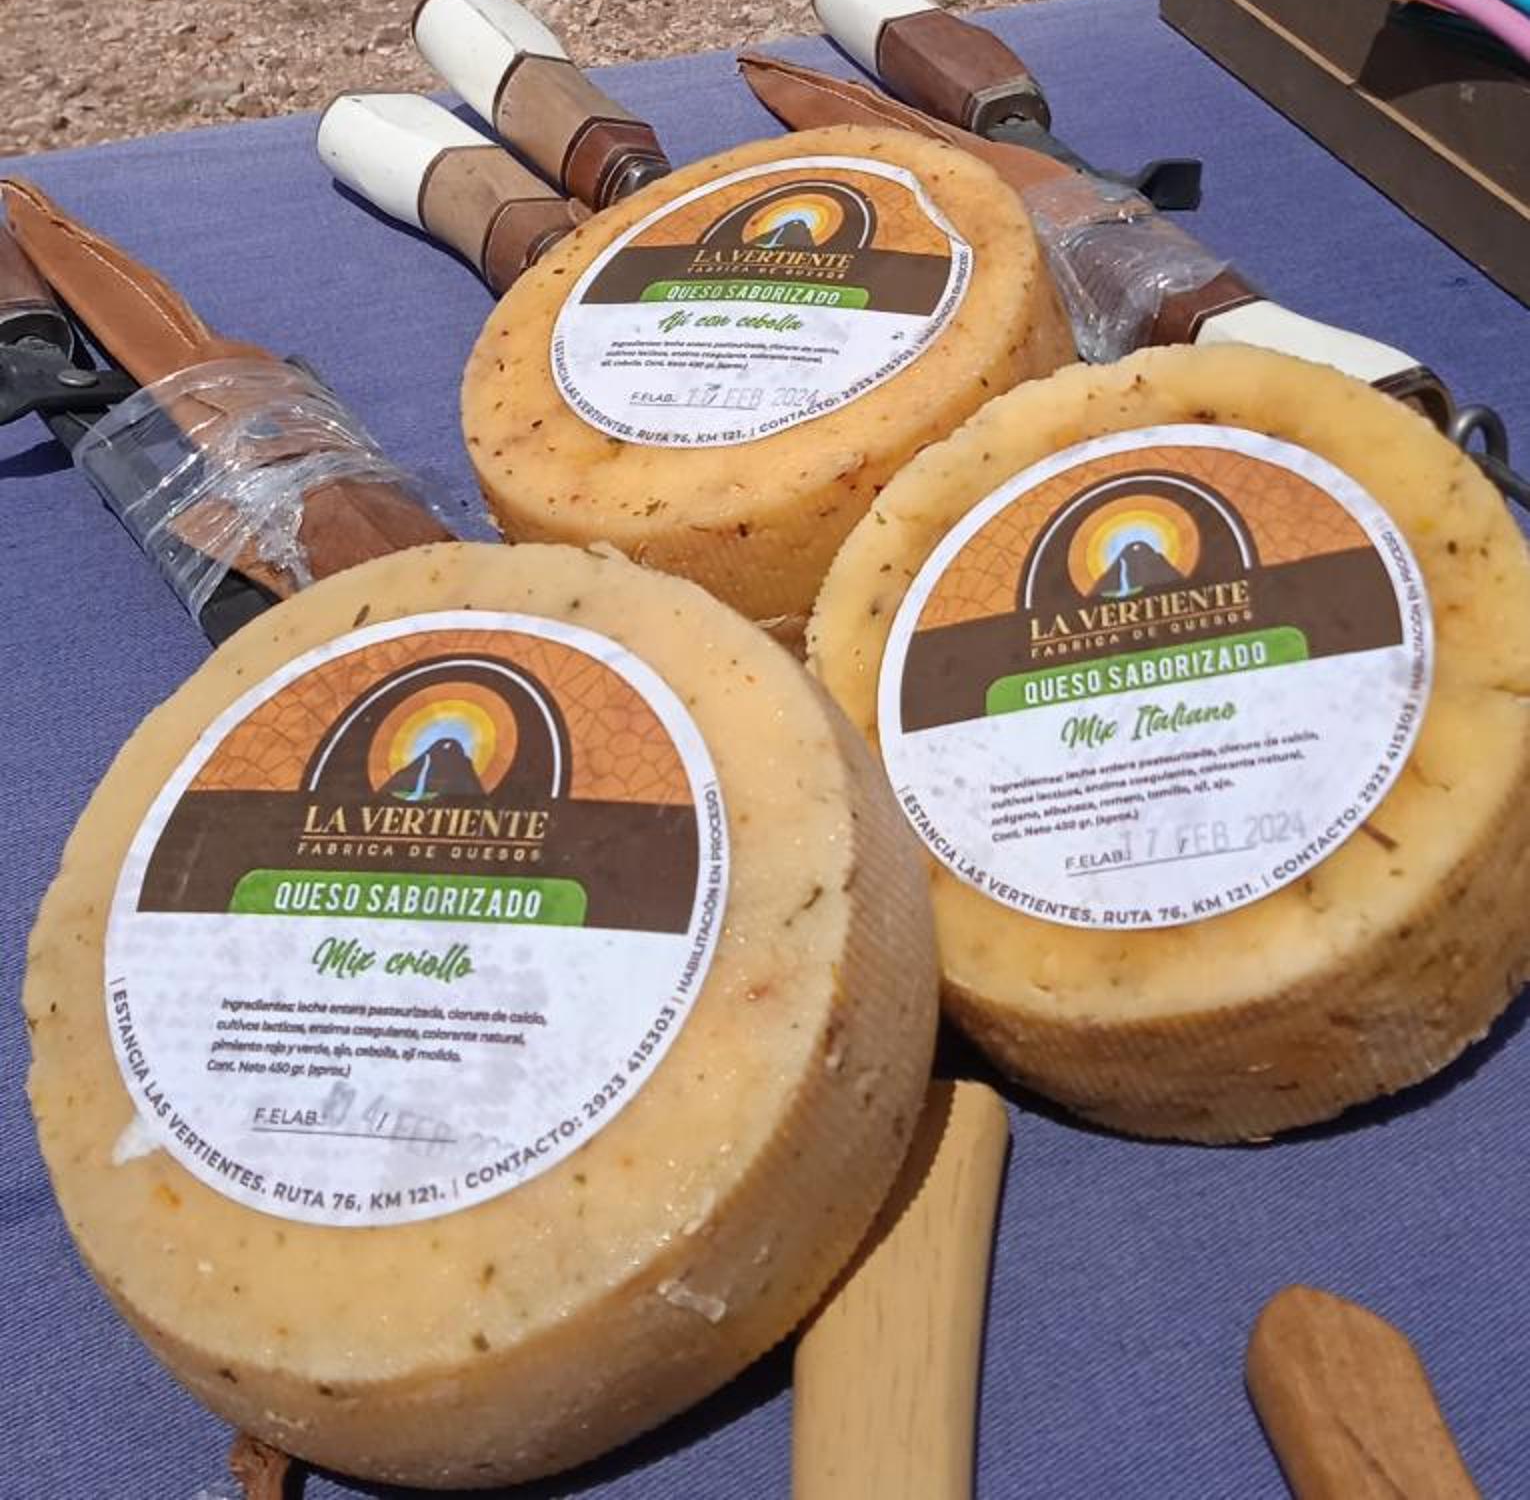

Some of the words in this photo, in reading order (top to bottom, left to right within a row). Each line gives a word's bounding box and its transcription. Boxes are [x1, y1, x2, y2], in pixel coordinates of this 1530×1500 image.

[694, 249, 722, 263] LA
[733, 249, 855, 268] VERTIENTE
[666, 285, 722, 300] QUESO
[725, 285, 841, 305] SABORIZADO
[736, 313, 803, 332] cebolla
[564, 382, 580, 400] LAS
[636, 430, 669, 443] RUTA
[695, 433, 717, 442] KM
[759, 397, 839, 434] CONTACTO:
[1031, 613, 1071, 640] LA
[1078, 579, 1250, 630] VERTIENTE
[1031, 637, 1120, 659] FABRICA
[1133, 627, 1156, 640] DE
[1170, 611, 1253, 633] QUESOS
[1024, 669, 1101, 704] QUESO
[1108, 641, 1268, 690] SABORIZADO
[1060, 713, 1118, 749] Mix
[1131, 701, 1237, 741] Italiano
[1272, 802, 1362, 881] CONTACTO:
[1358, 764, 1391, 802] 2923
[1386, 702, 1418, 760] 415303
[303, 804, 347, 834] LA
[360, 806, 549, 839] VERTIENTE
[705, 789, 722, 861] PROCESO
[1176, 820, 1230, 854] FEB
[1244, 811, 1308, 848] 2024
[297, 841, 395, 856] FABRICA
[409, 844, 437, 859] DE
[451, 846, 543, 863] QUESOS
[708, 864, 722, 885] EN
[903, 793, 956, 863] ESTANCIA
[957, 855, 987, 884] LAS
[1102, 909, 1153, 924] RUTA
[1193, 898, 1223, 913] KM
[274, 882, 361, 911] QUESO
[367, 884, 542, 918] SABORIZADO
[311, 936, 376, 979] Mix
[384, 943, 475, 984] criollo
[238, 1060, 266, 1074] Neto
[112, 989, 147, 1083] ESTANCIA
[143, 1081, 171, 1117] LAS
[273, 1181, 326, 1209] RUTA
[370, 1191, 402, 1208] KM
[408, 1185, 446, 1205] 121.
[465, 1115, 583, 1189] CONTACTO:
[582, 1073, 627, 1119] 2923
[627, 1005, 676, 1073] 415303
